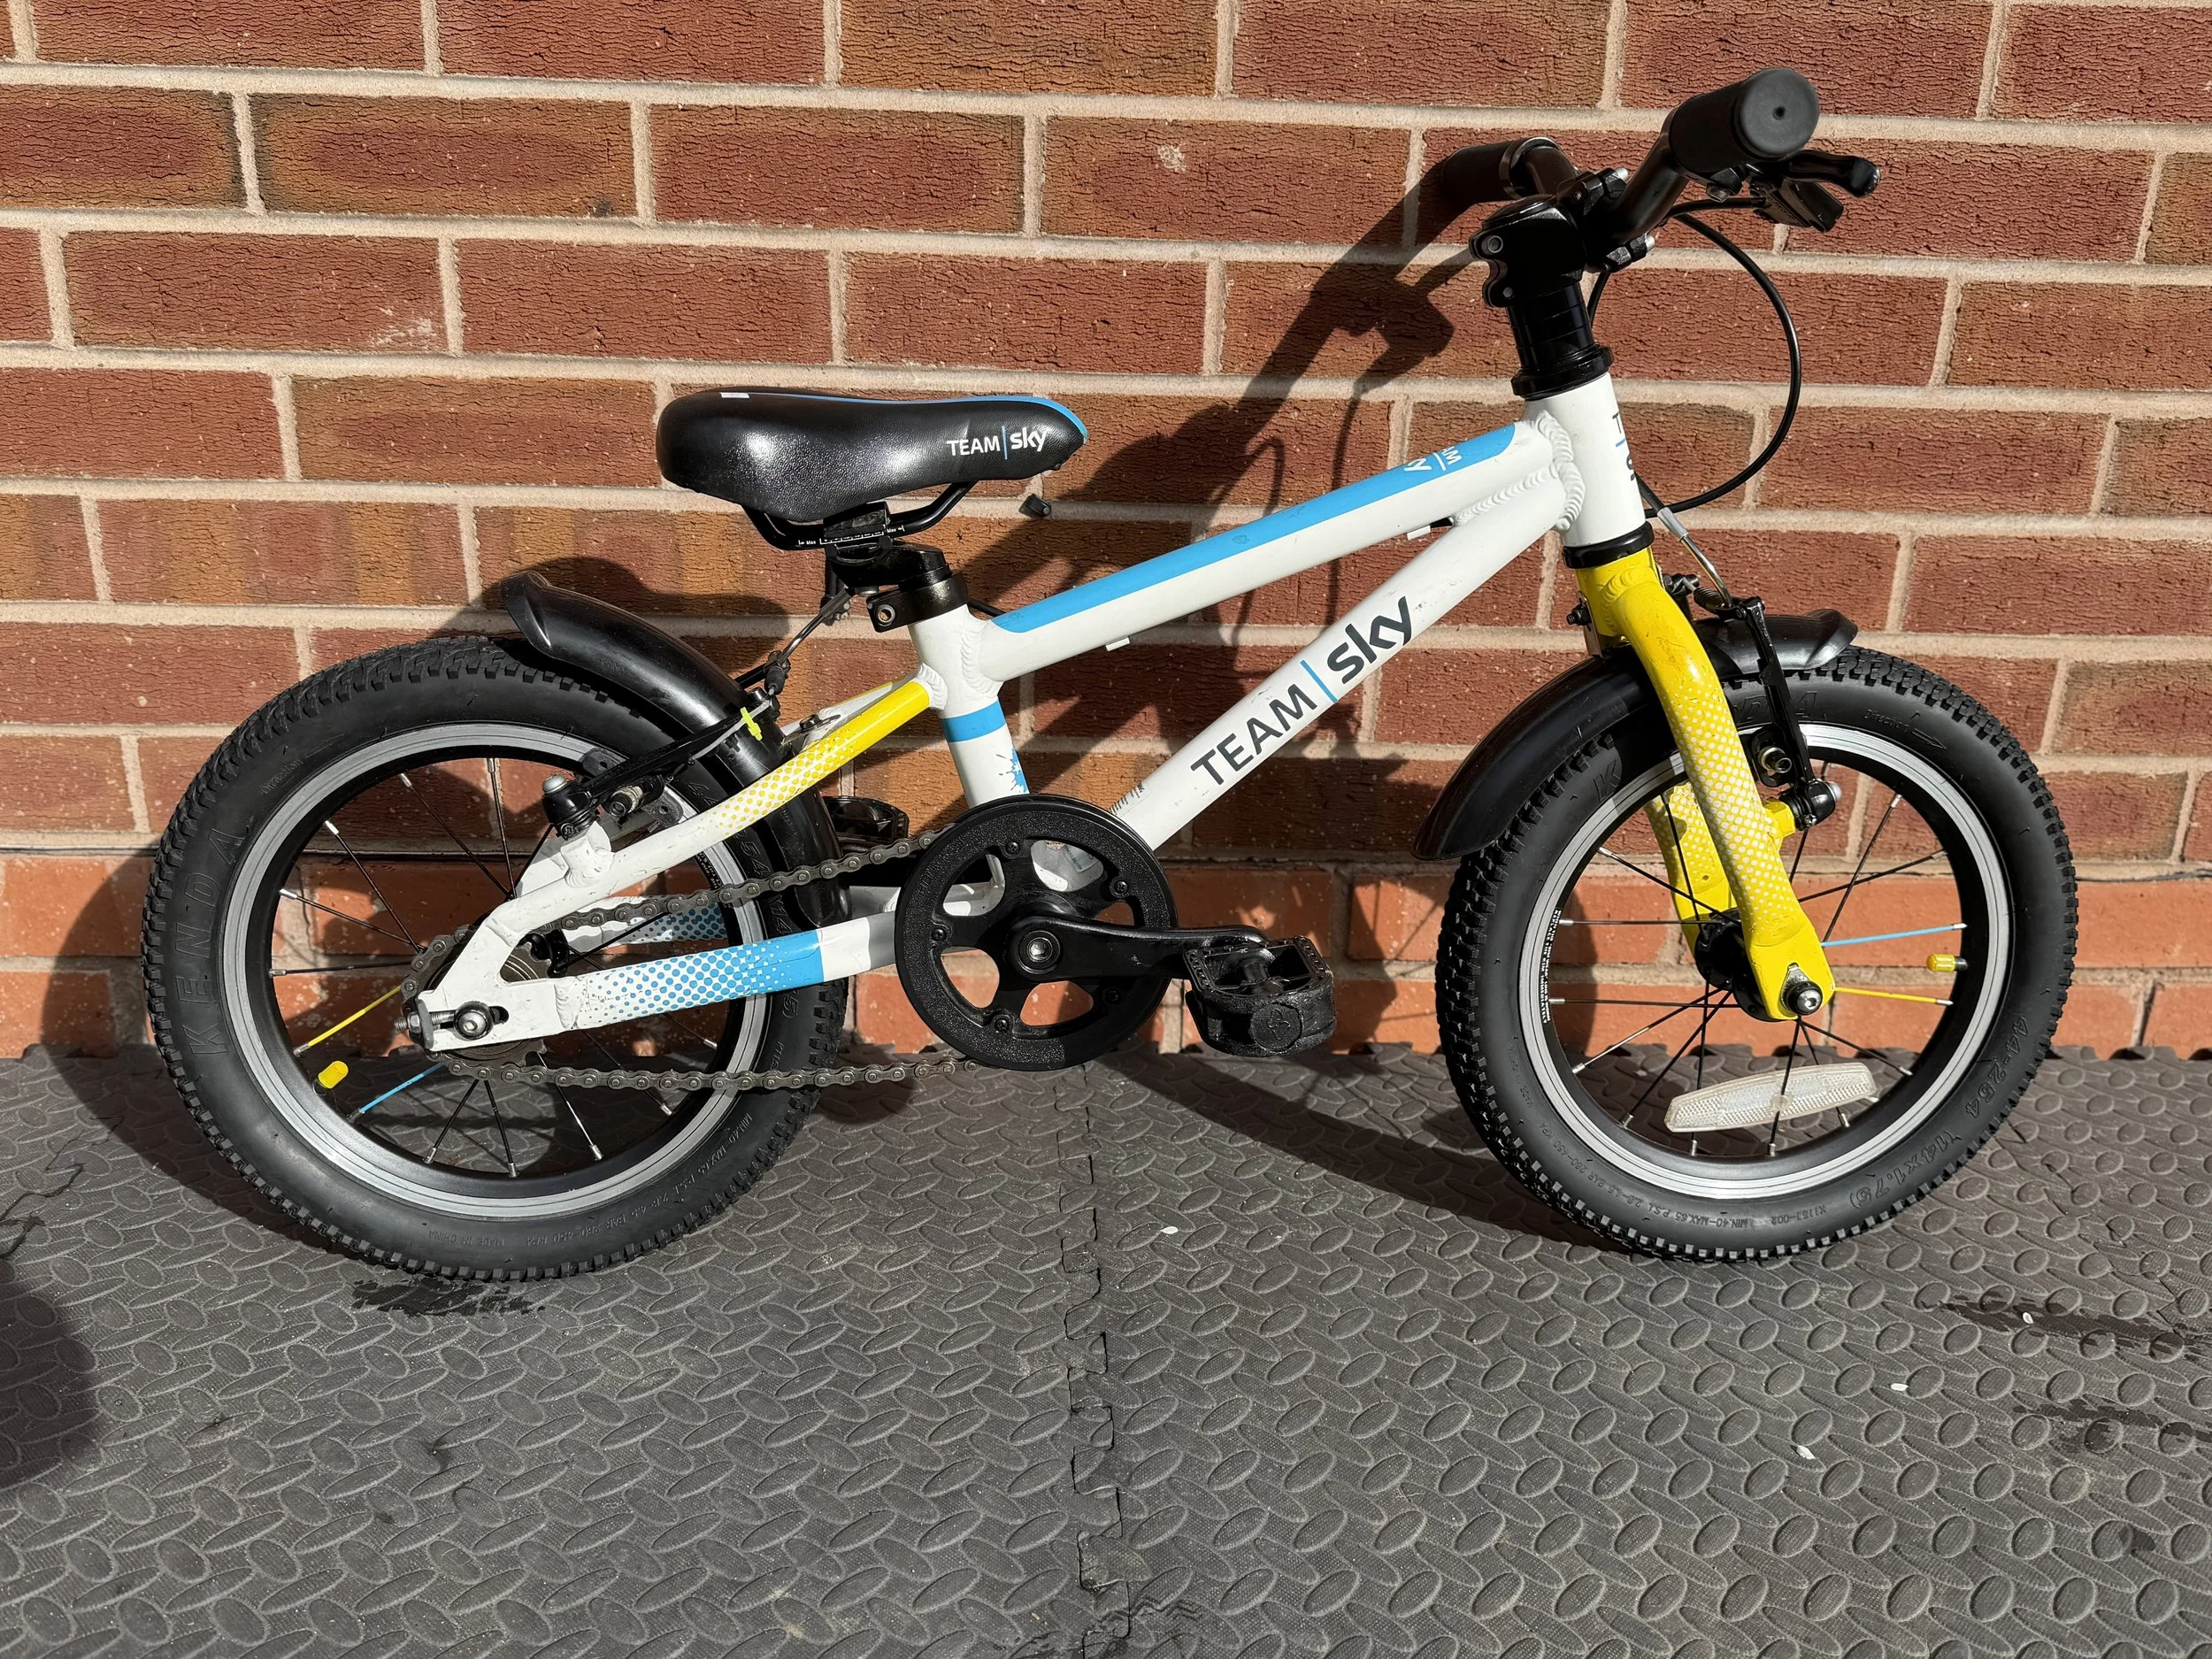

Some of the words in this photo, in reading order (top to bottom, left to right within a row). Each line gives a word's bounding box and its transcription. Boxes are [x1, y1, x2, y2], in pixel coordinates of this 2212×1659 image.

[946, 435, 1001, 456] TEAM
[1010, 426, 1048, 452] sky
[1190, 683, 1318, 786] TEAM
[1326, 595, 1412, 685] sky
[1862, 708, 1909, 735] Direction
[175, 828, 246, 1055] KENDA
[1964, 1017, 2029, 1118] 44-254
[426, 1229, 457, 1243] CHINA
[461, 1234, 472, 1246] IN
[476, 1236, 504, 1247] MADE
